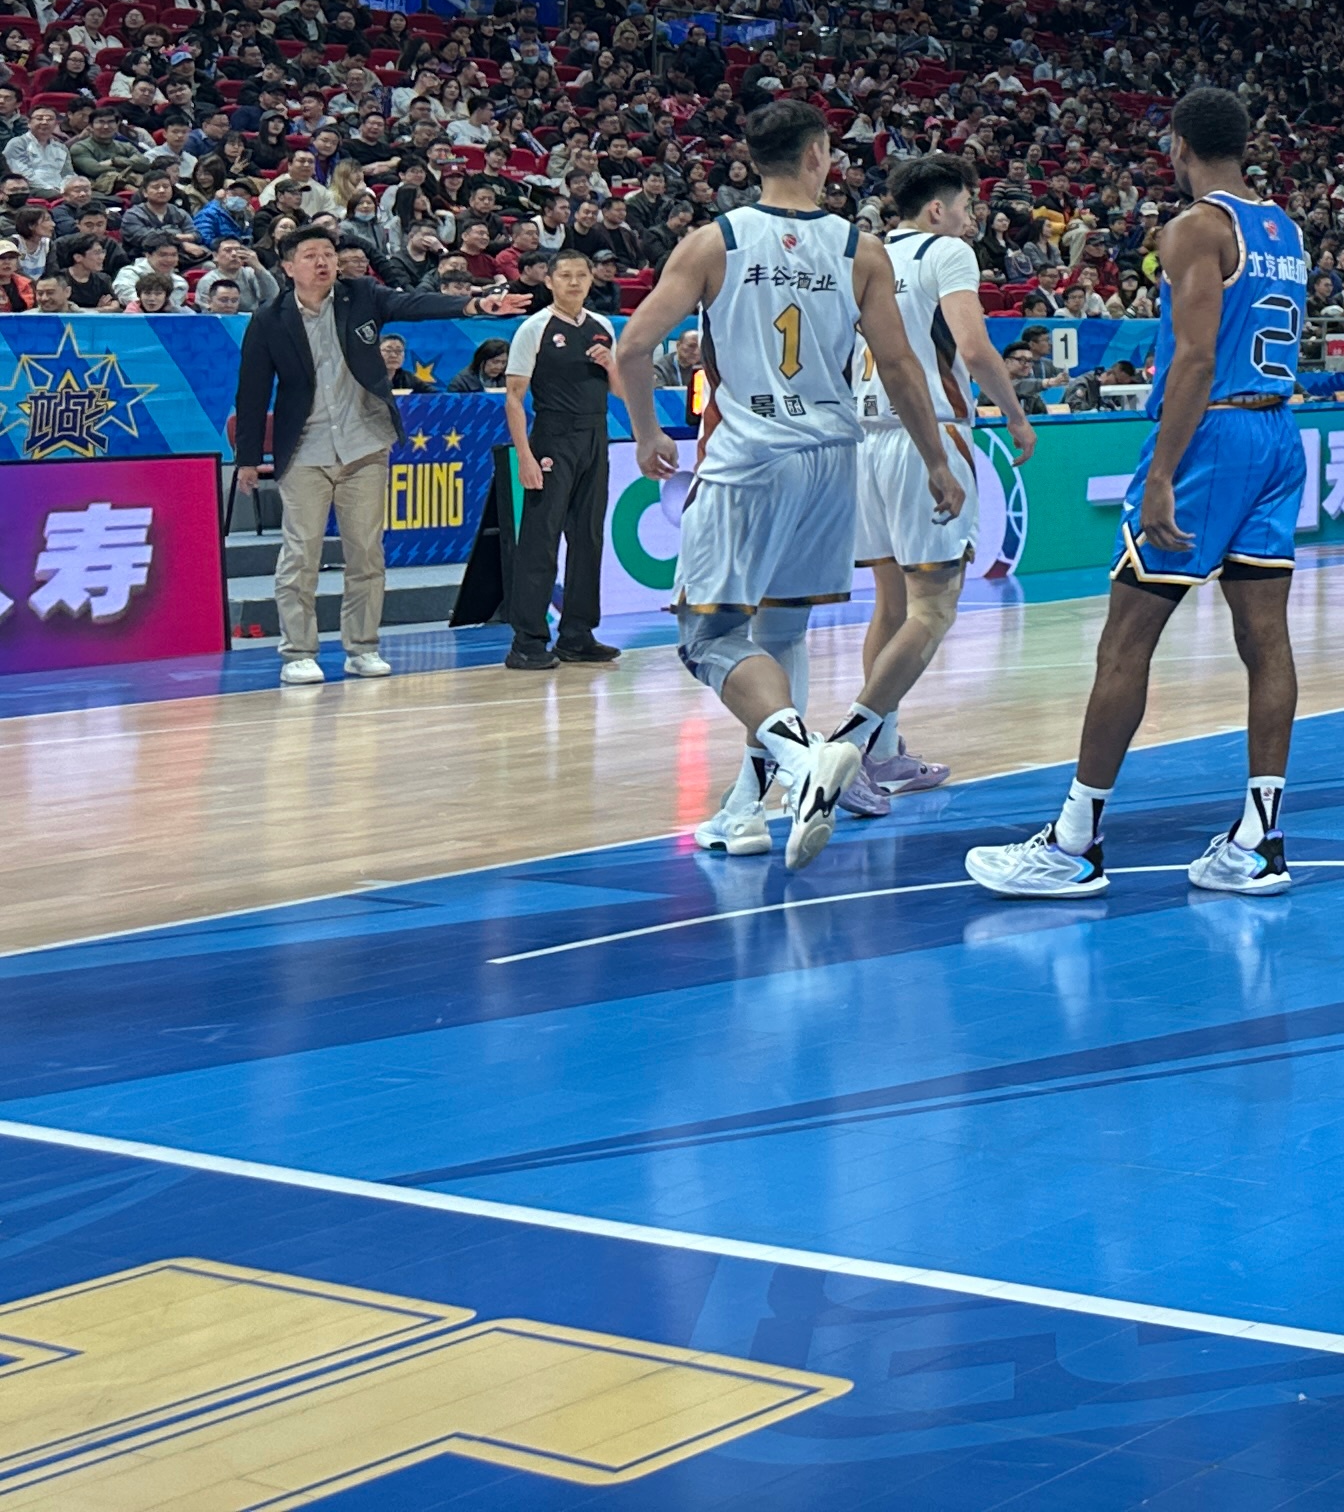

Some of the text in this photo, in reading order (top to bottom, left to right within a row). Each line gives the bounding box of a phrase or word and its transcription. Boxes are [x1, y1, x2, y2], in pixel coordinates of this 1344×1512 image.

[744, 264, 837, 292] 丰谷酒业
[774, 303, 803, 380] 1
[1060, 333, 1070, 361] 1
[1251, 294, 1301, 381] 2
[385, 461, 464, 531] EIJING
[0, 502, 153, 623] 寿
